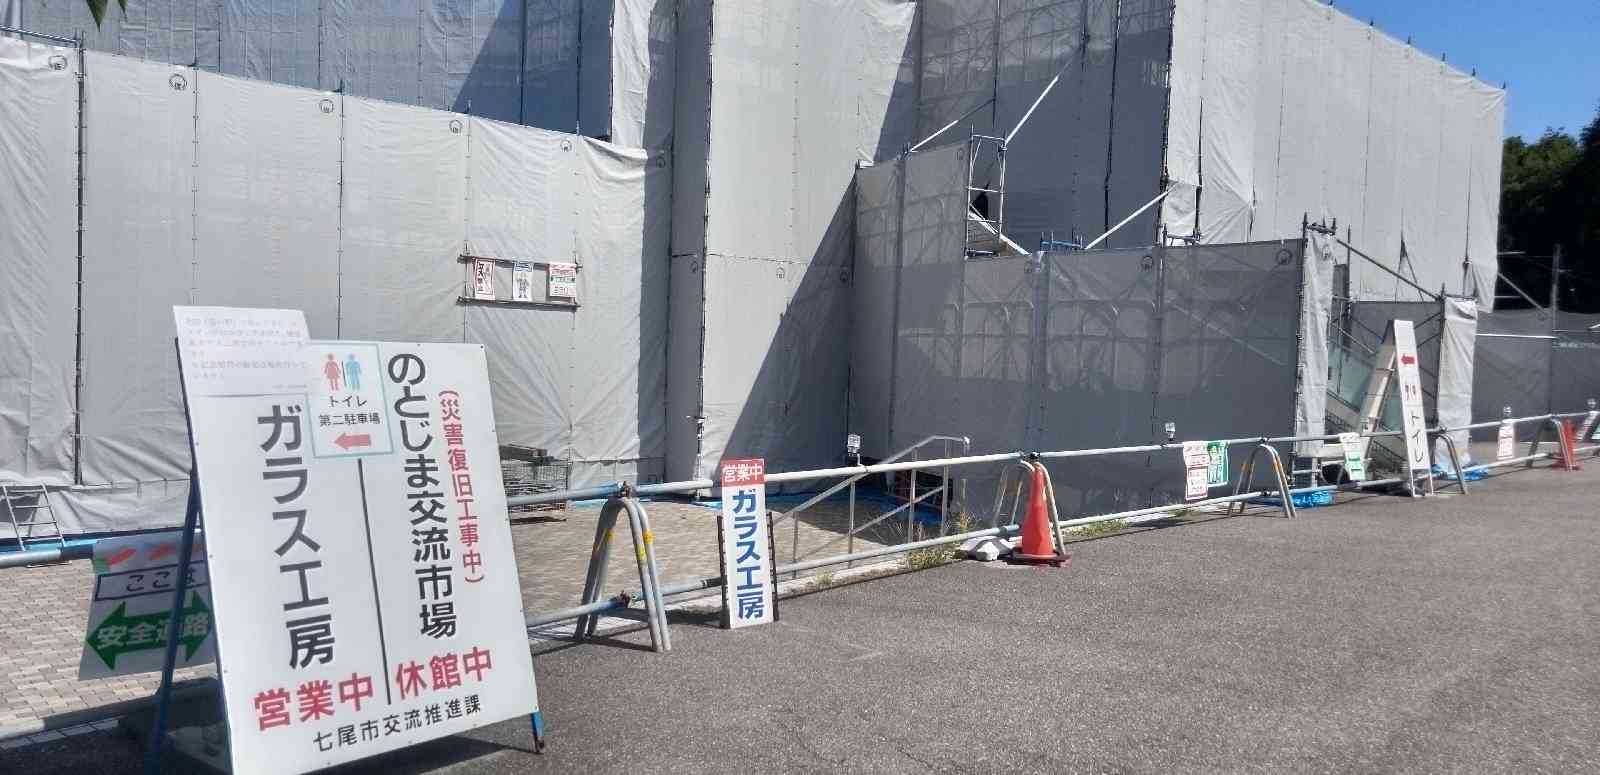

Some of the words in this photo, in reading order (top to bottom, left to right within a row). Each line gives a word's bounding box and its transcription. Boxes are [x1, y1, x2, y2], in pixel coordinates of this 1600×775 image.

[319, 412, 381, 427] 第二駐車場
[329, 395, 367, 407] トイレ
[1409, 414, 1424, 464] トイレ
[388, 353, 457, 639] のとじま交流市場
[722, 463, 763, 482] 営業中
[257, 404, 335, 669] ガラス工房
[732, 489, 765, 619] ガラス工房
[395, 646, 492, 700] 休館中
[254, 672, 374, 731] 営業中
[313, 694, 481, 752] 七尾市交流推進課
